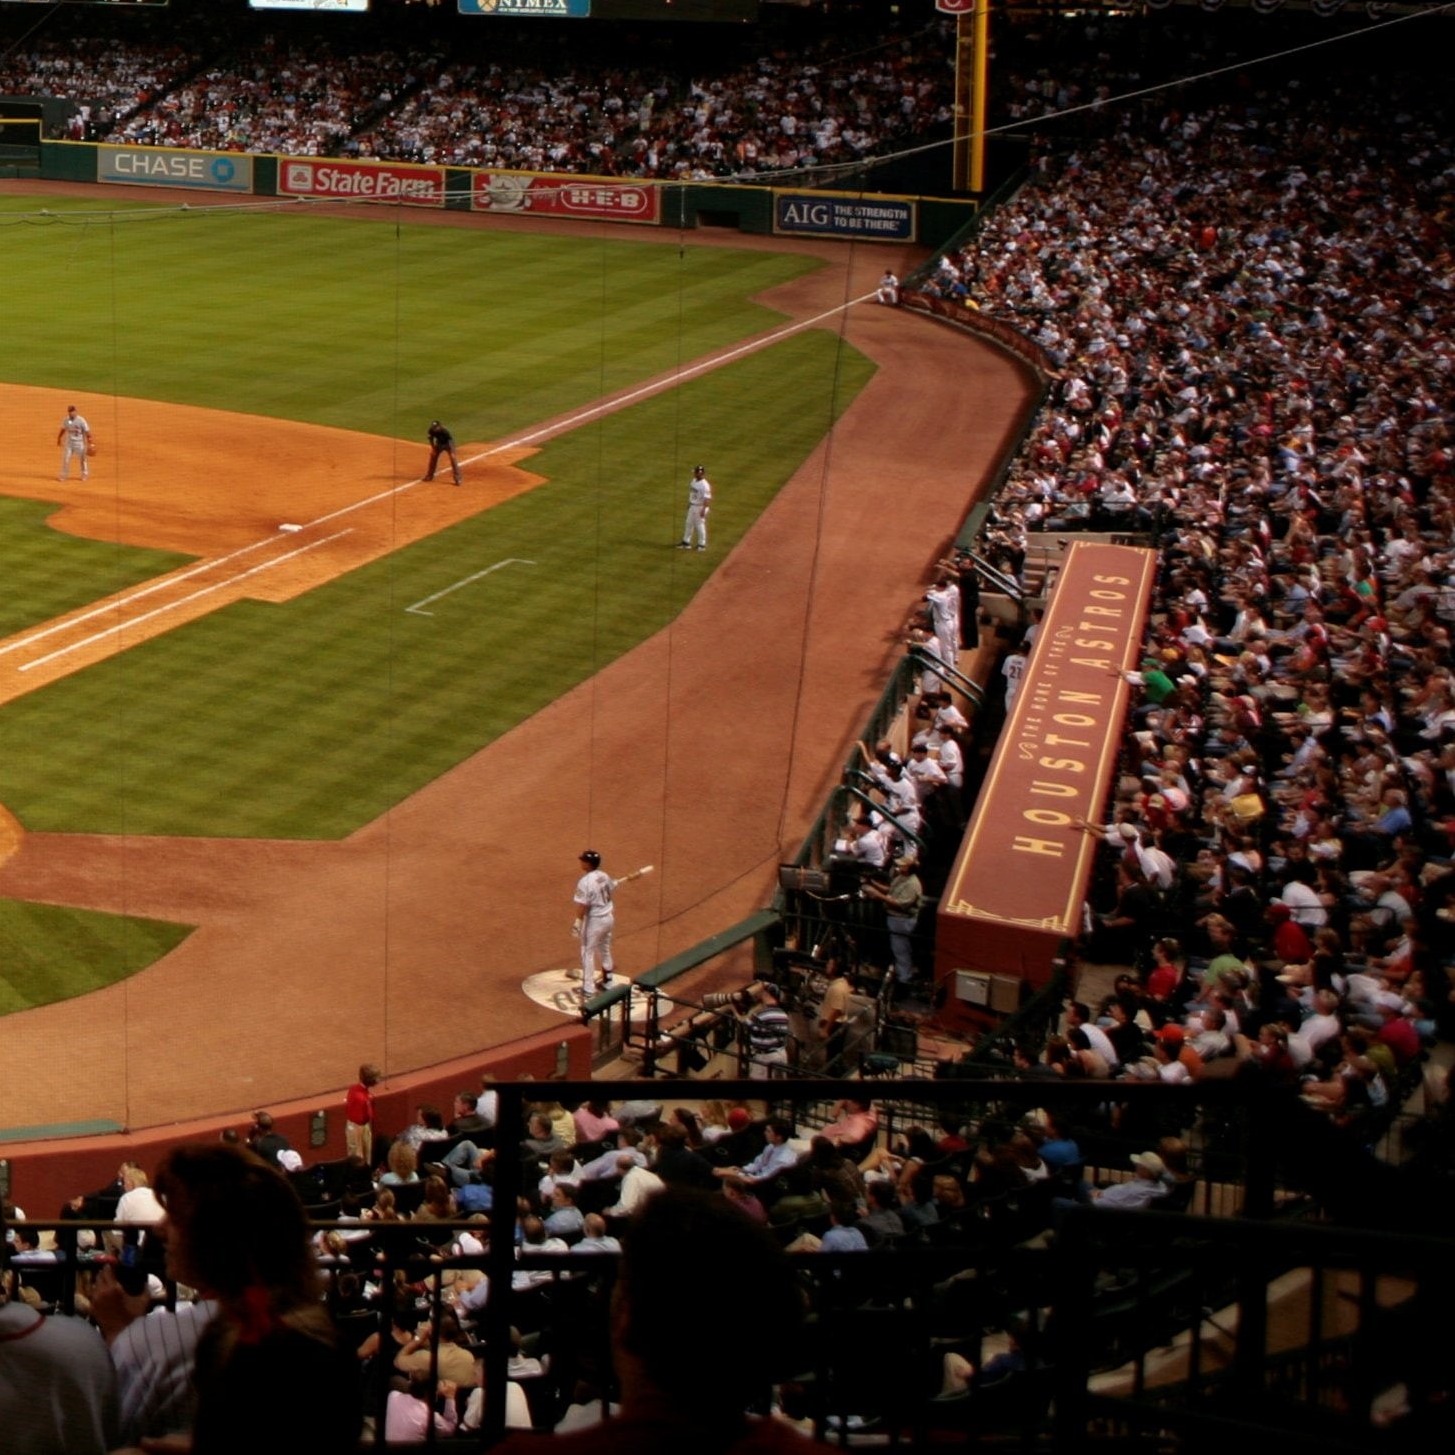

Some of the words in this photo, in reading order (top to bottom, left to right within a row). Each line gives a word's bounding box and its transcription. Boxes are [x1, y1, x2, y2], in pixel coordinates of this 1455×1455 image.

[113, 153, 205, 178] CHASE
[315, 167, 373, 194] State
[783, 202, 828, 225] AIG
[833, 205, 852, 216] THE
[854, 206, 908, 220] STRENGTH
[833, 216, 847, 227] TO
[848, 217, 863, 229] BE
[1012, 689, 1103, 858] HOUSTON
[1069, 573, 1131, 670] ASTROS
